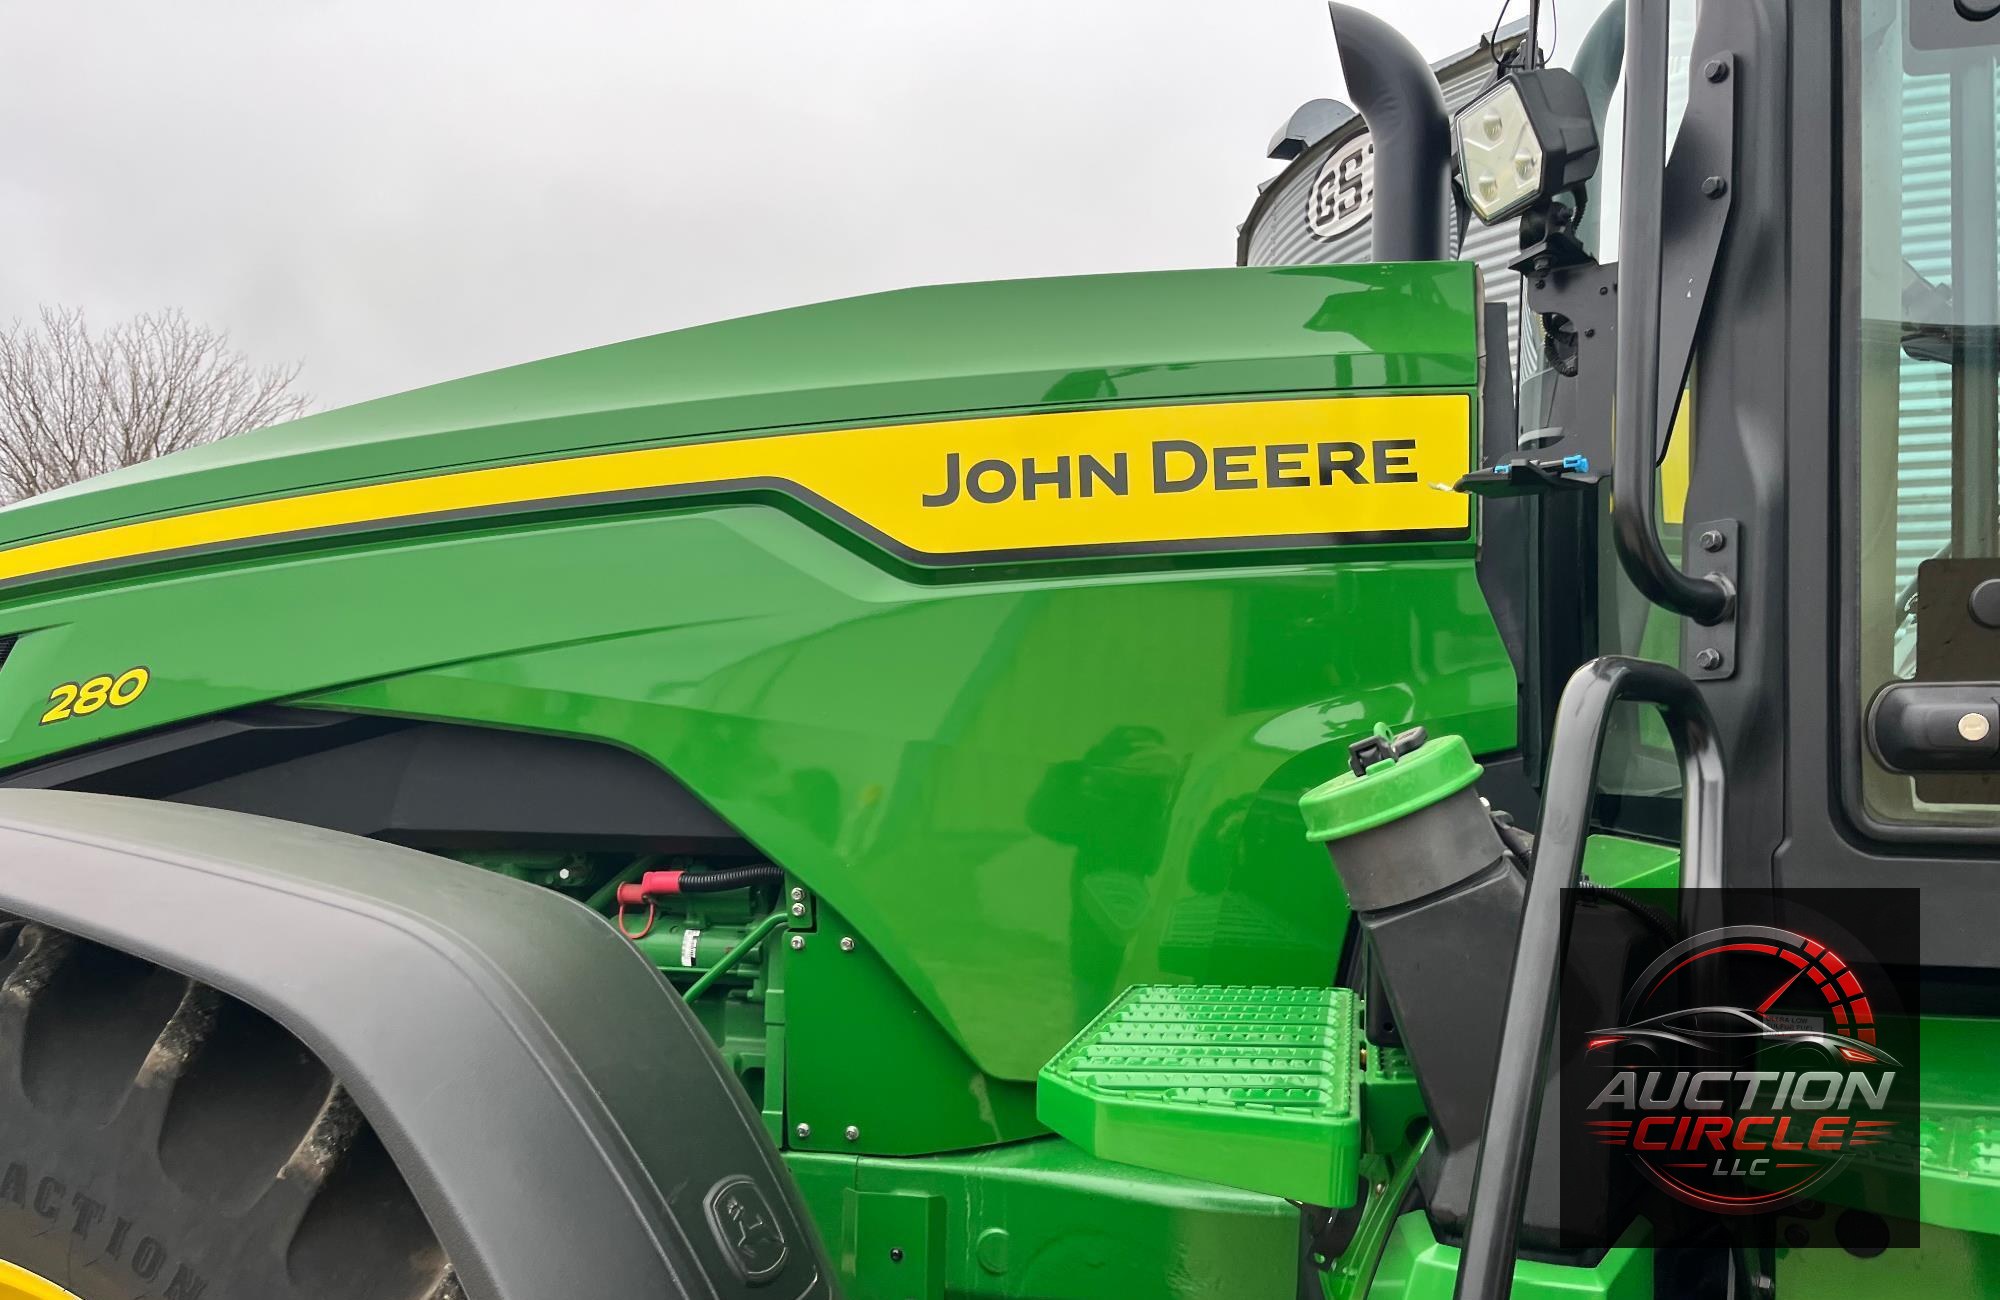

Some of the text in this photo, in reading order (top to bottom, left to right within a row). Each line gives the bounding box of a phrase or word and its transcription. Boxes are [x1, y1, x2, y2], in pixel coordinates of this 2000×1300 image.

[1316, 143, 1374, 226] GS
[922, 439, 1418, 507] JOHN DEERE
[39, 666, 150, 726] 280
